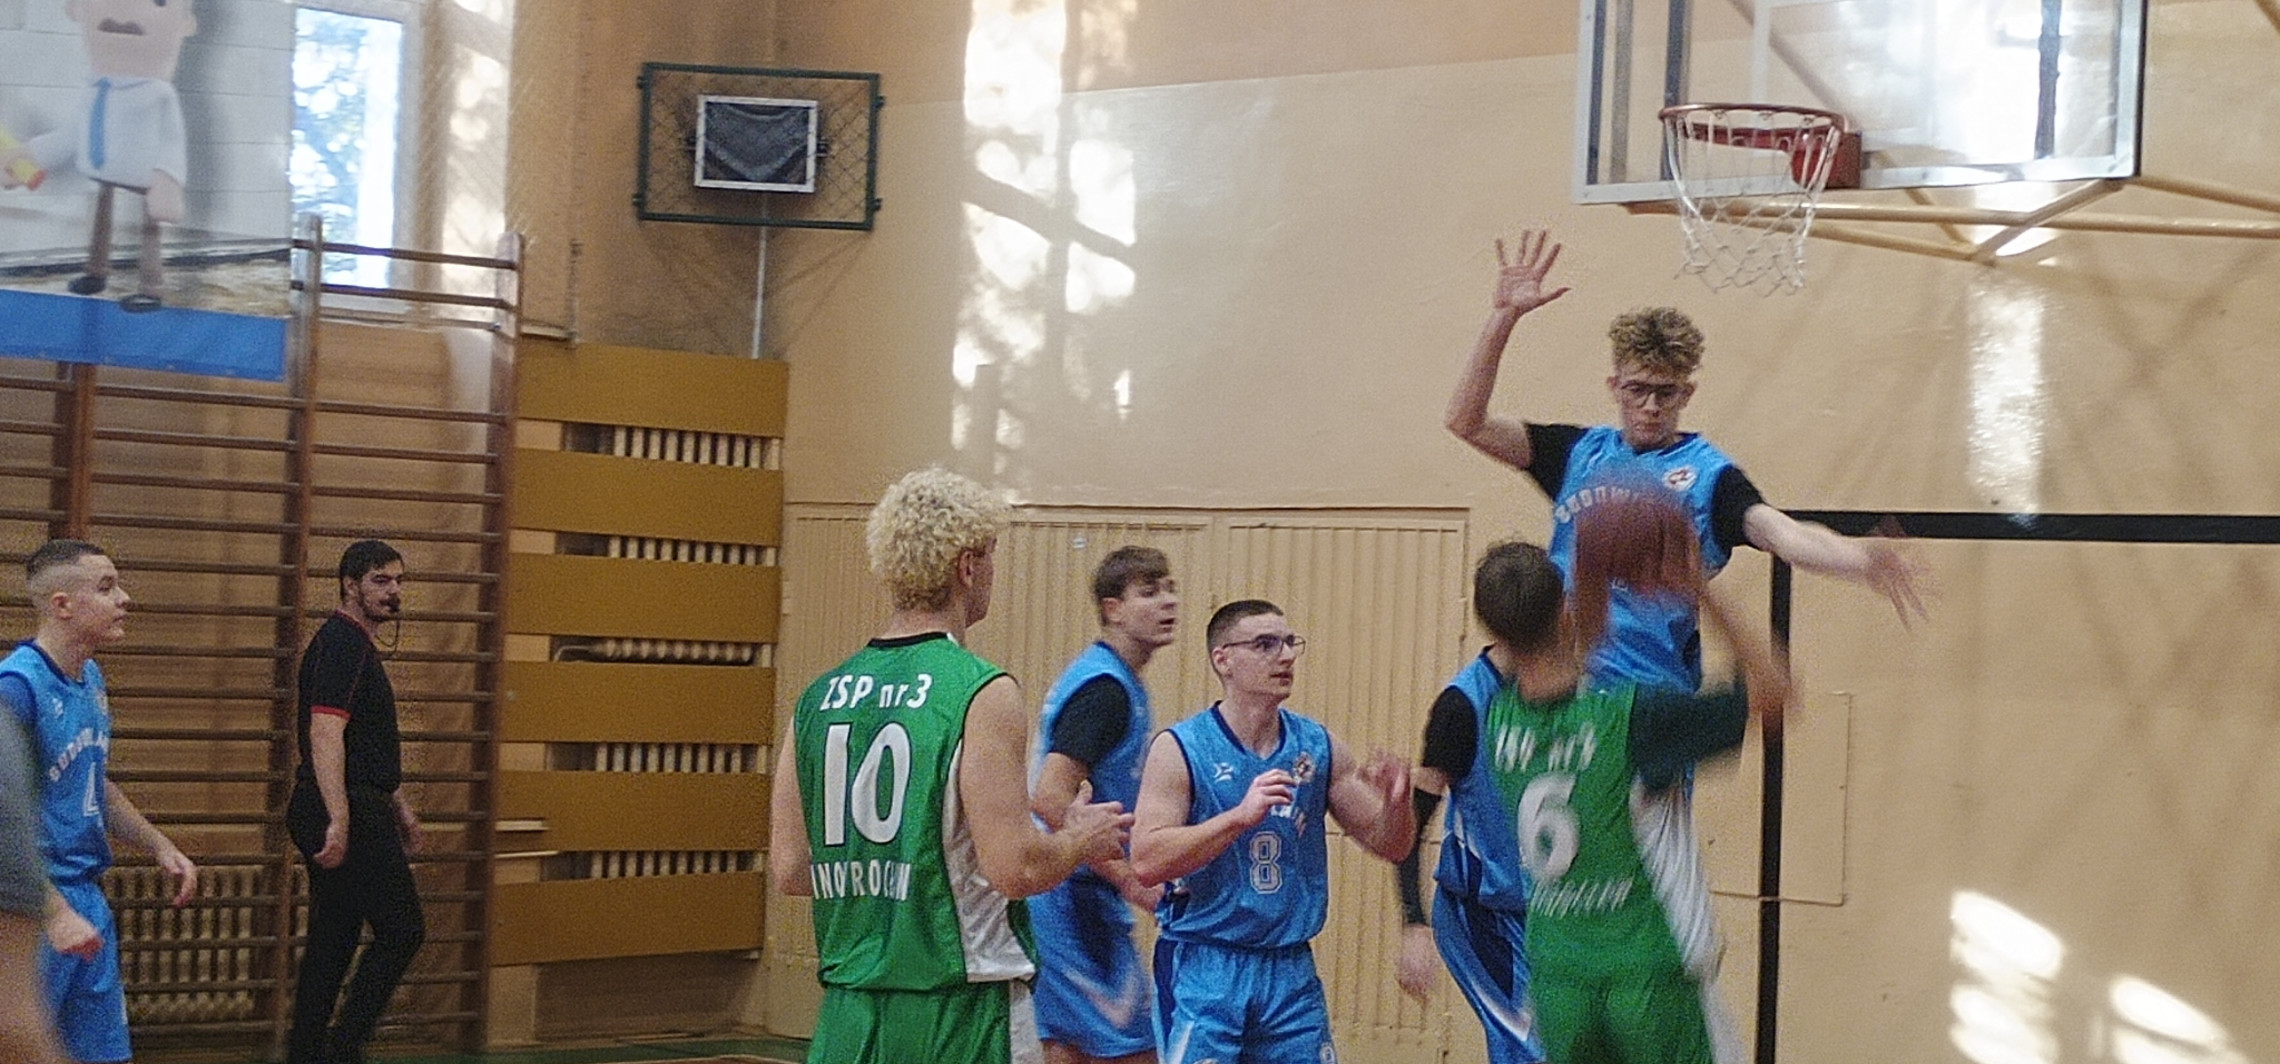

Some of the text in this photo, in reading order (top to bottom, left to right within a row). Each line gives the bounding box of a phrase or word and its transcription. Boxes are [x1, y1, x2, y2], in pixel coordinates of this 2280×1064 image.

[820, 675, 874, 711] ZSP
[824, 721, 912, 845] 10
[1518, 771, 1581, 882] 6
[1249, 831, 1283, 894] 8
